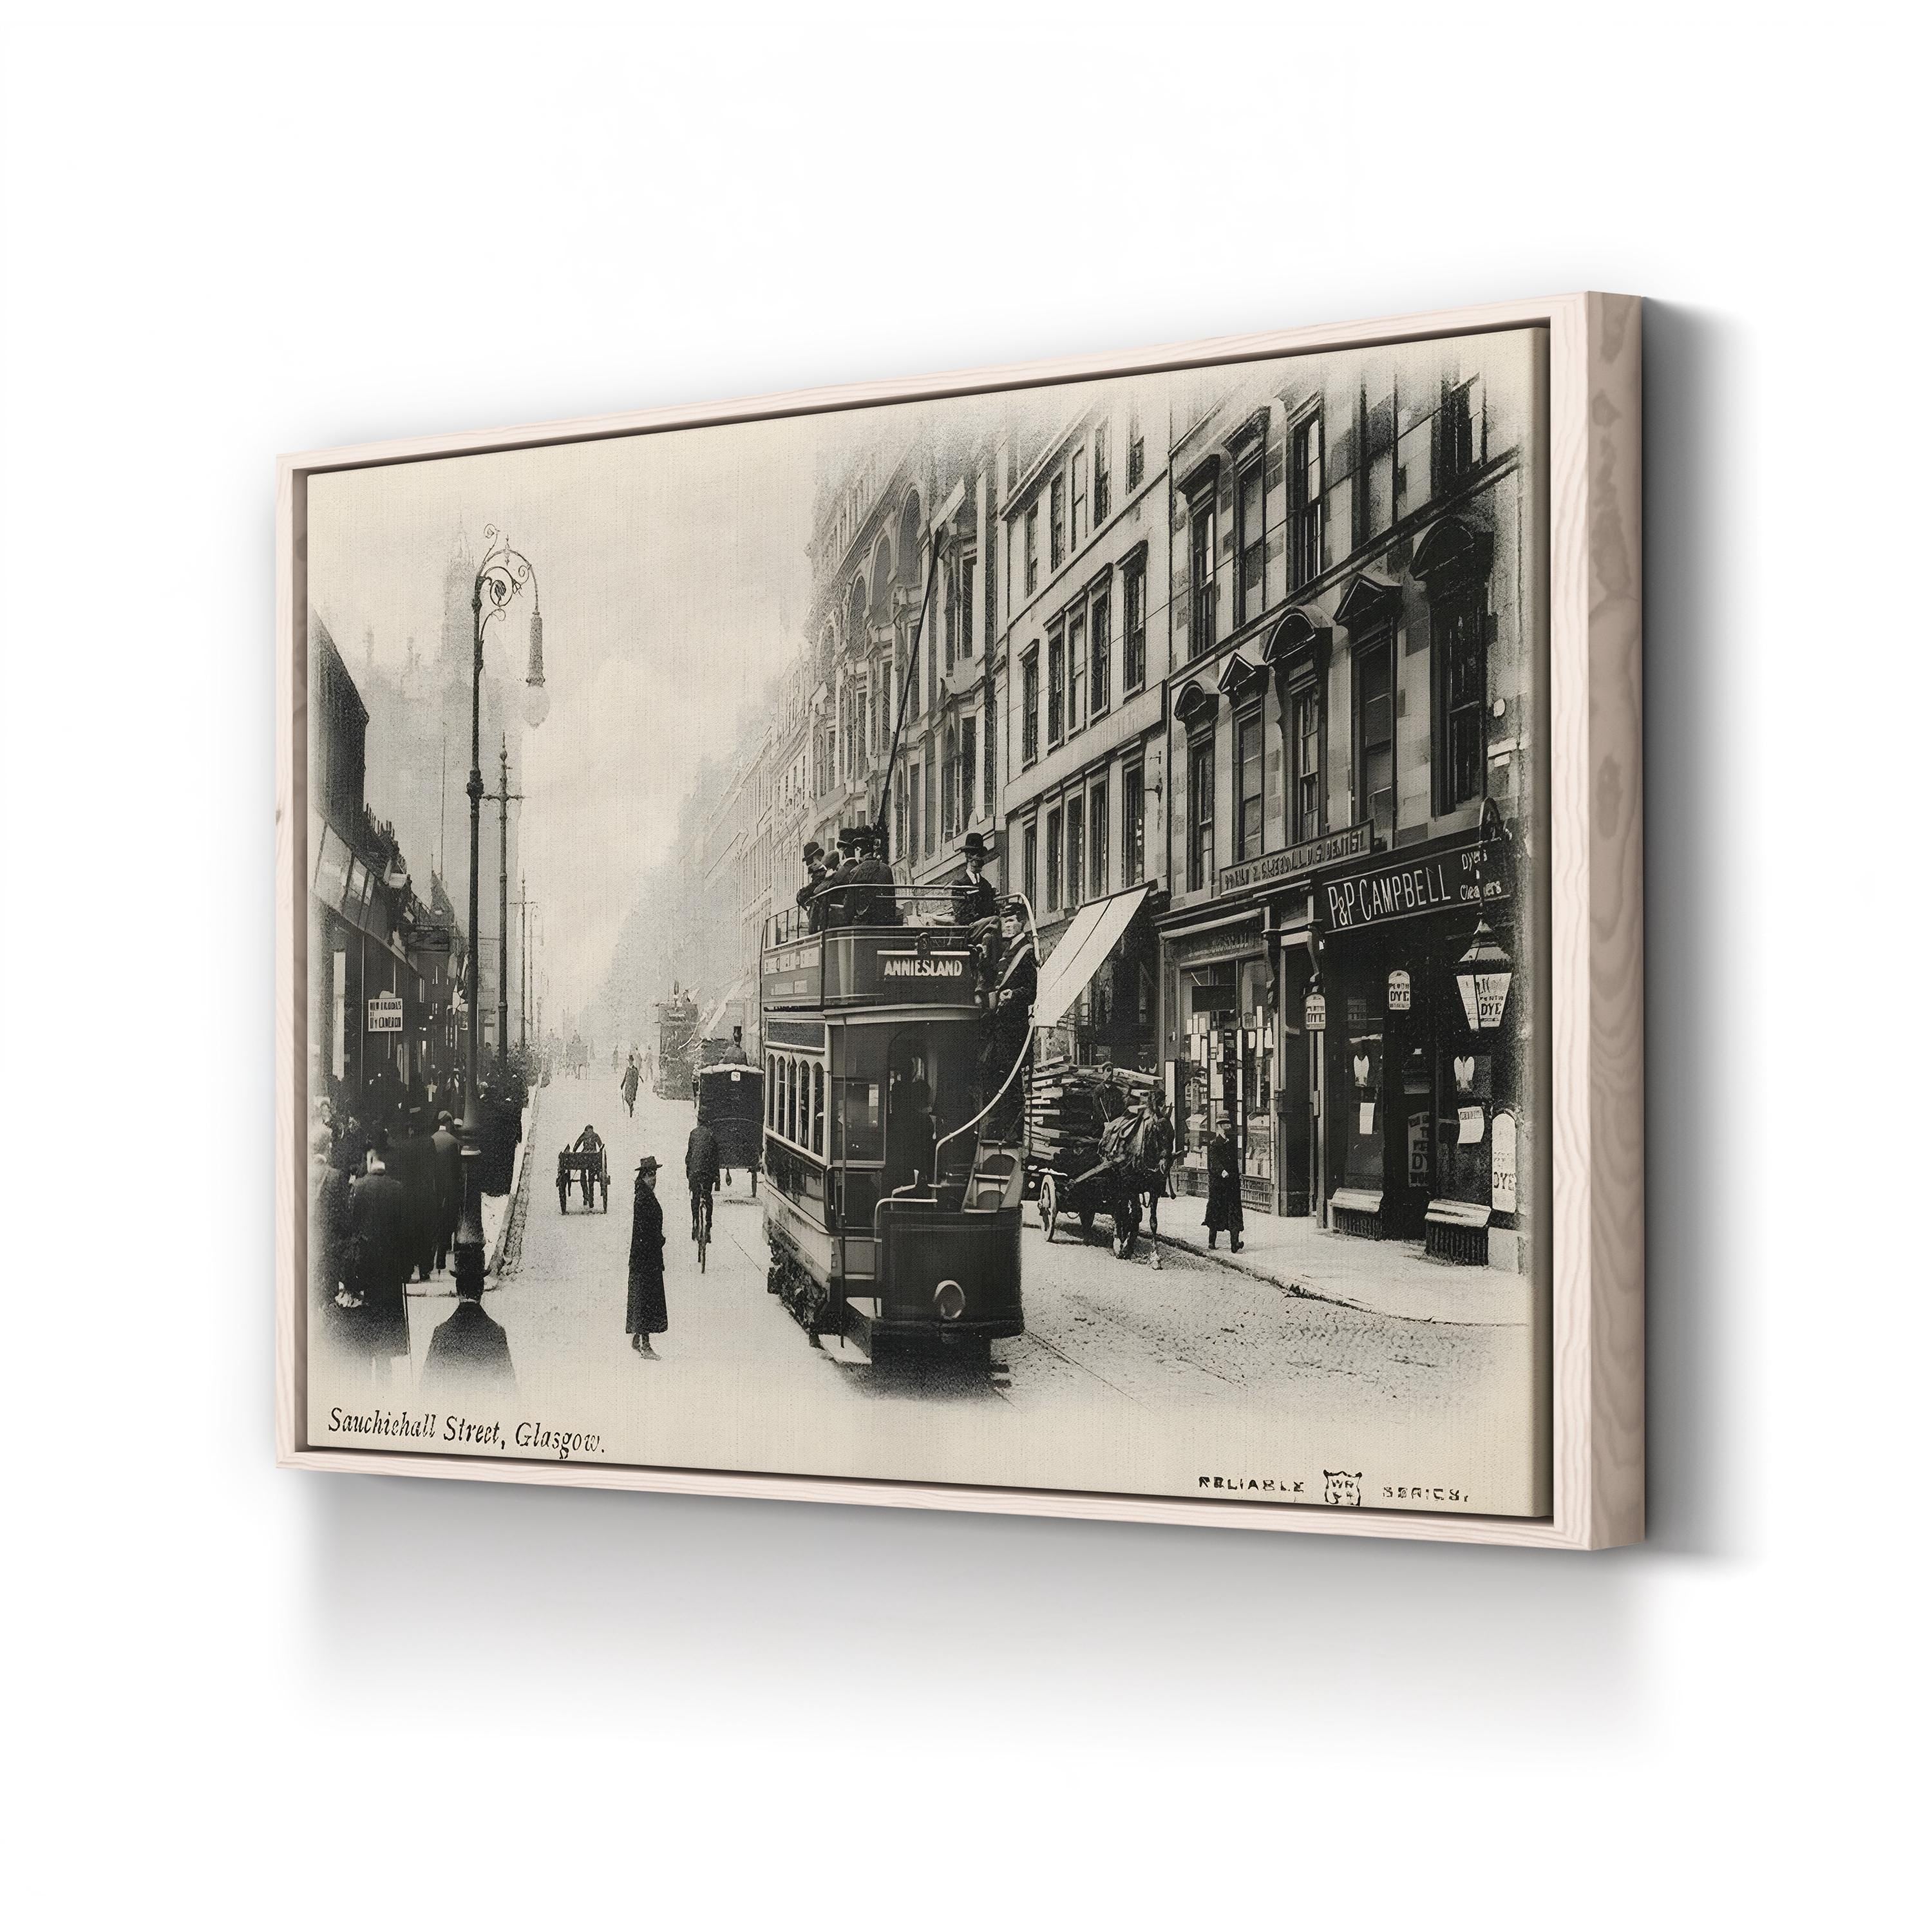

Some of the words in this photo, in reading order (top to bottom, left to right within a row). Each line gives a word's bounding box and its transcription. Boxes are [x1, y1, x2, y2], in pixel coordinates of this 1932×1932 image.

[1328, 880, 1355, 928] P&P
[1359, 864, 1451, 921] CAMPBELL
[884, 960, 963, 976] ANNIESLAND
[1390, 991, 1409, 1001] DYE
[1481, 1003, 1502, 1016] DYE
[328, 1407, 436, 1438] Sauchiehall
[443, 1416, 506, 1450] Street,
[515, 1423, 605, 1459] Glasgow.
